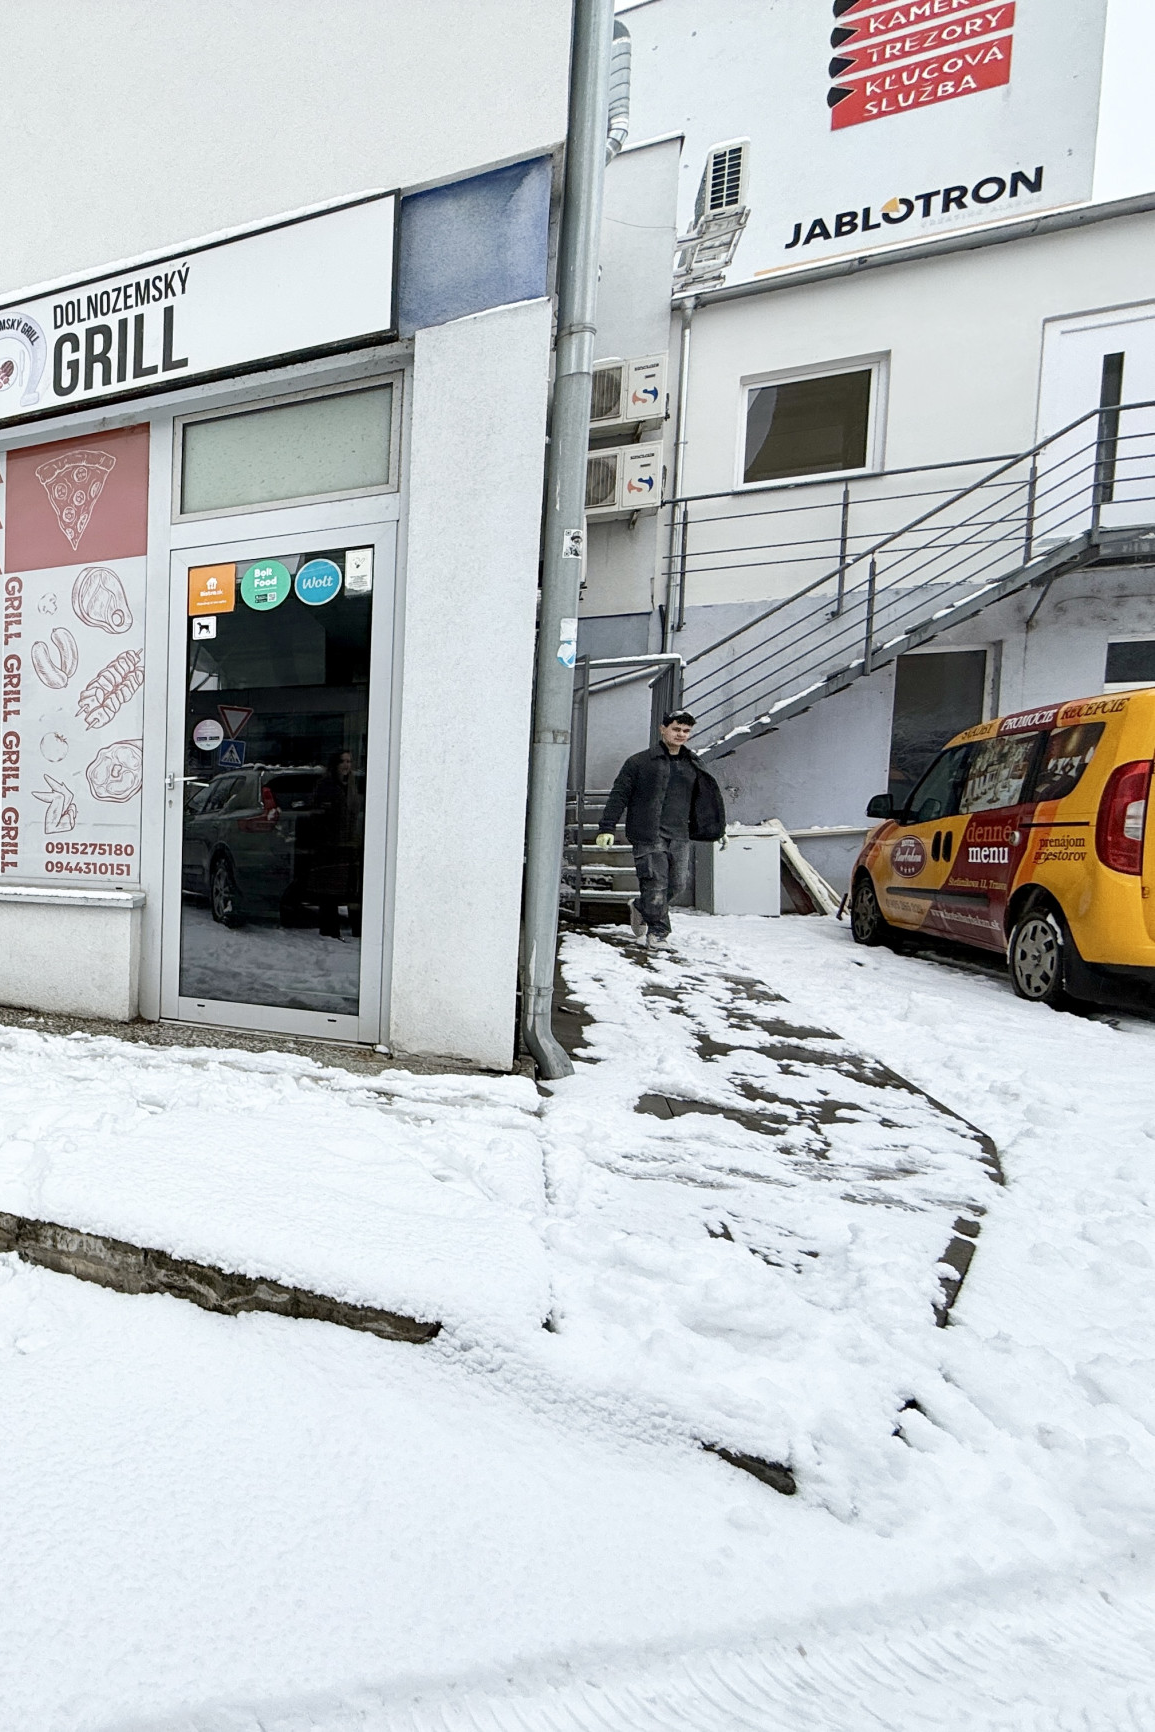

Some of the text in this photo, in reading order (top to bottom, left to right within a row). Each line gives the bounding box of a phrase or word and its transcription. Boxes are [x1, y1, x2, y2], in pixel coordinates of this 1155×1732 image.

[869, 0, 981, 33] KAMER
[867, 8, 1006, 63] TREZORY
[865, 41, 1004, 96] KĽÚČOVÁ
[863, 75, 977, 116] SLUŽBA
[785, 166, 1044, 249] JABLOTRON
[53, 262, 190, 330] DOLNOZEMSKÝ
[21, 320, 41, 346] GRILL
[53, 305, 189, 397] GRILL
[254, 568, 273, 578] Bolt
[254, 576, 277, 588] Food
[302, 575, 333, 589] Wolt
[1060, 697, 1130, 720] RECEPCIE
[1, 576, 23, 873] GRILL GRILL GRILL GRILL
[966, 821, 1012, 843] denné
[1039, 834, 1085, 851] prenájom
[45, 842, 134, 857] 0915275180
[968, 846, 1009, 863] menu
[44, 860, 131, 876] 0944310151
